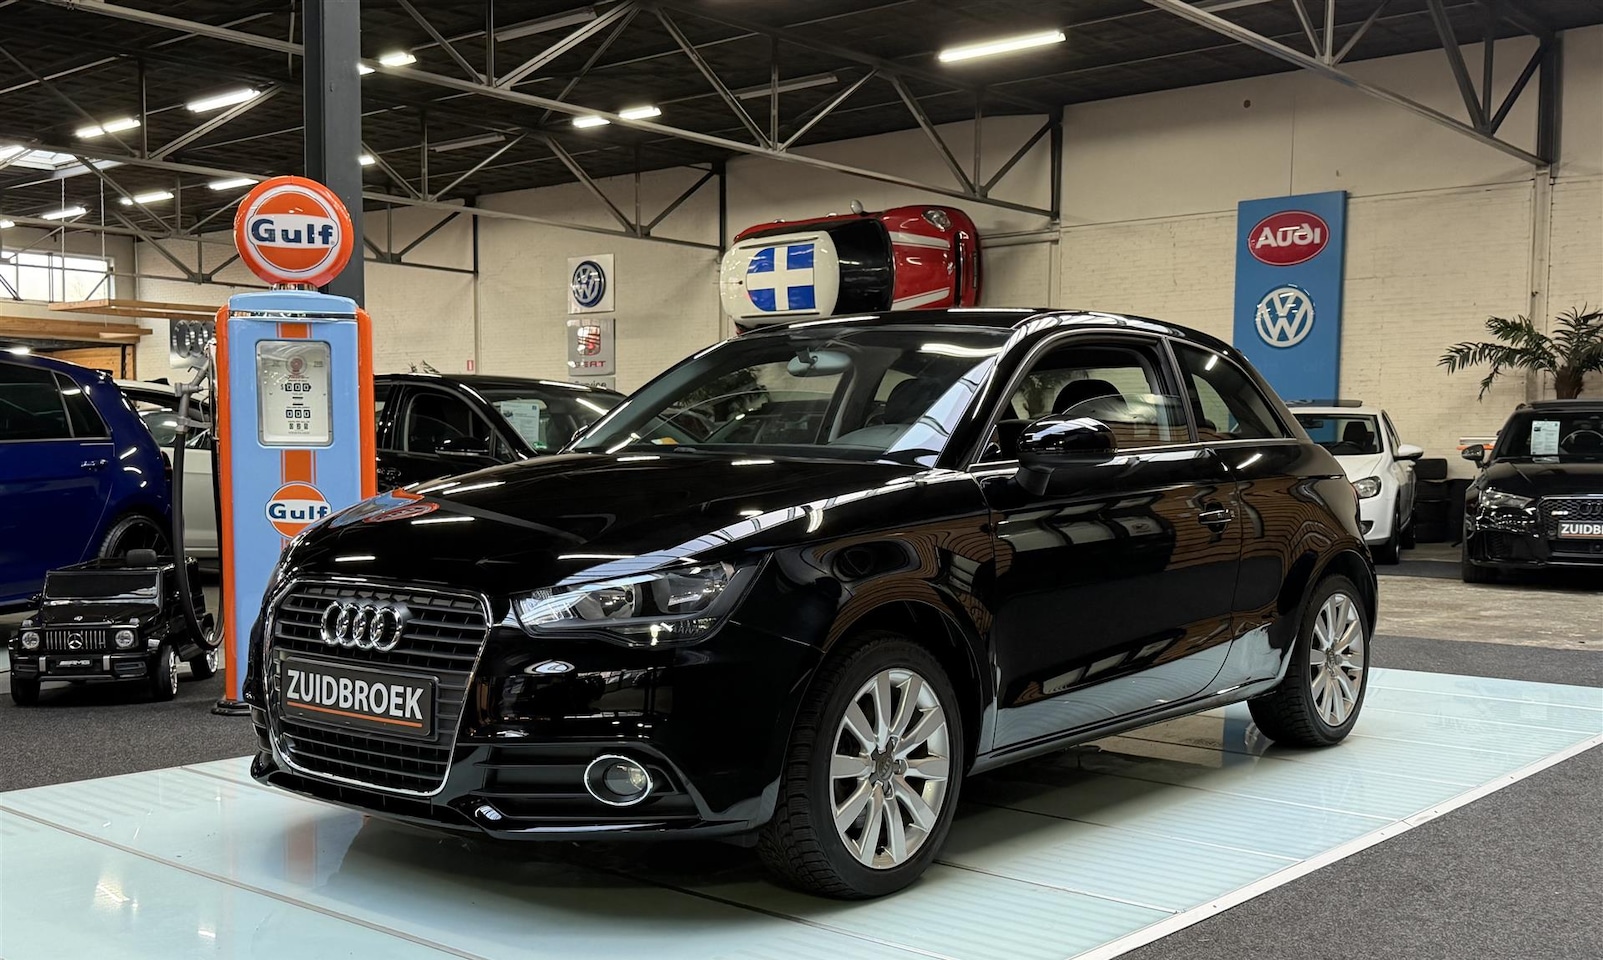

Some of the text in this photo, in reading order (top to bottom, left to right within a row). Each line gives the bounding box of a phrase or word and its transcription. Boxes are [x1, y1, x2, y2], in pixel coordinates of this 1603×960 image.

[251, 218, 334, 245] Gulf
[268, 503, 328, 520] Gulf
[1561, 523, 1603, 536] ZUIDB
[286, 669, 424, 720] ZUIDBROEK
